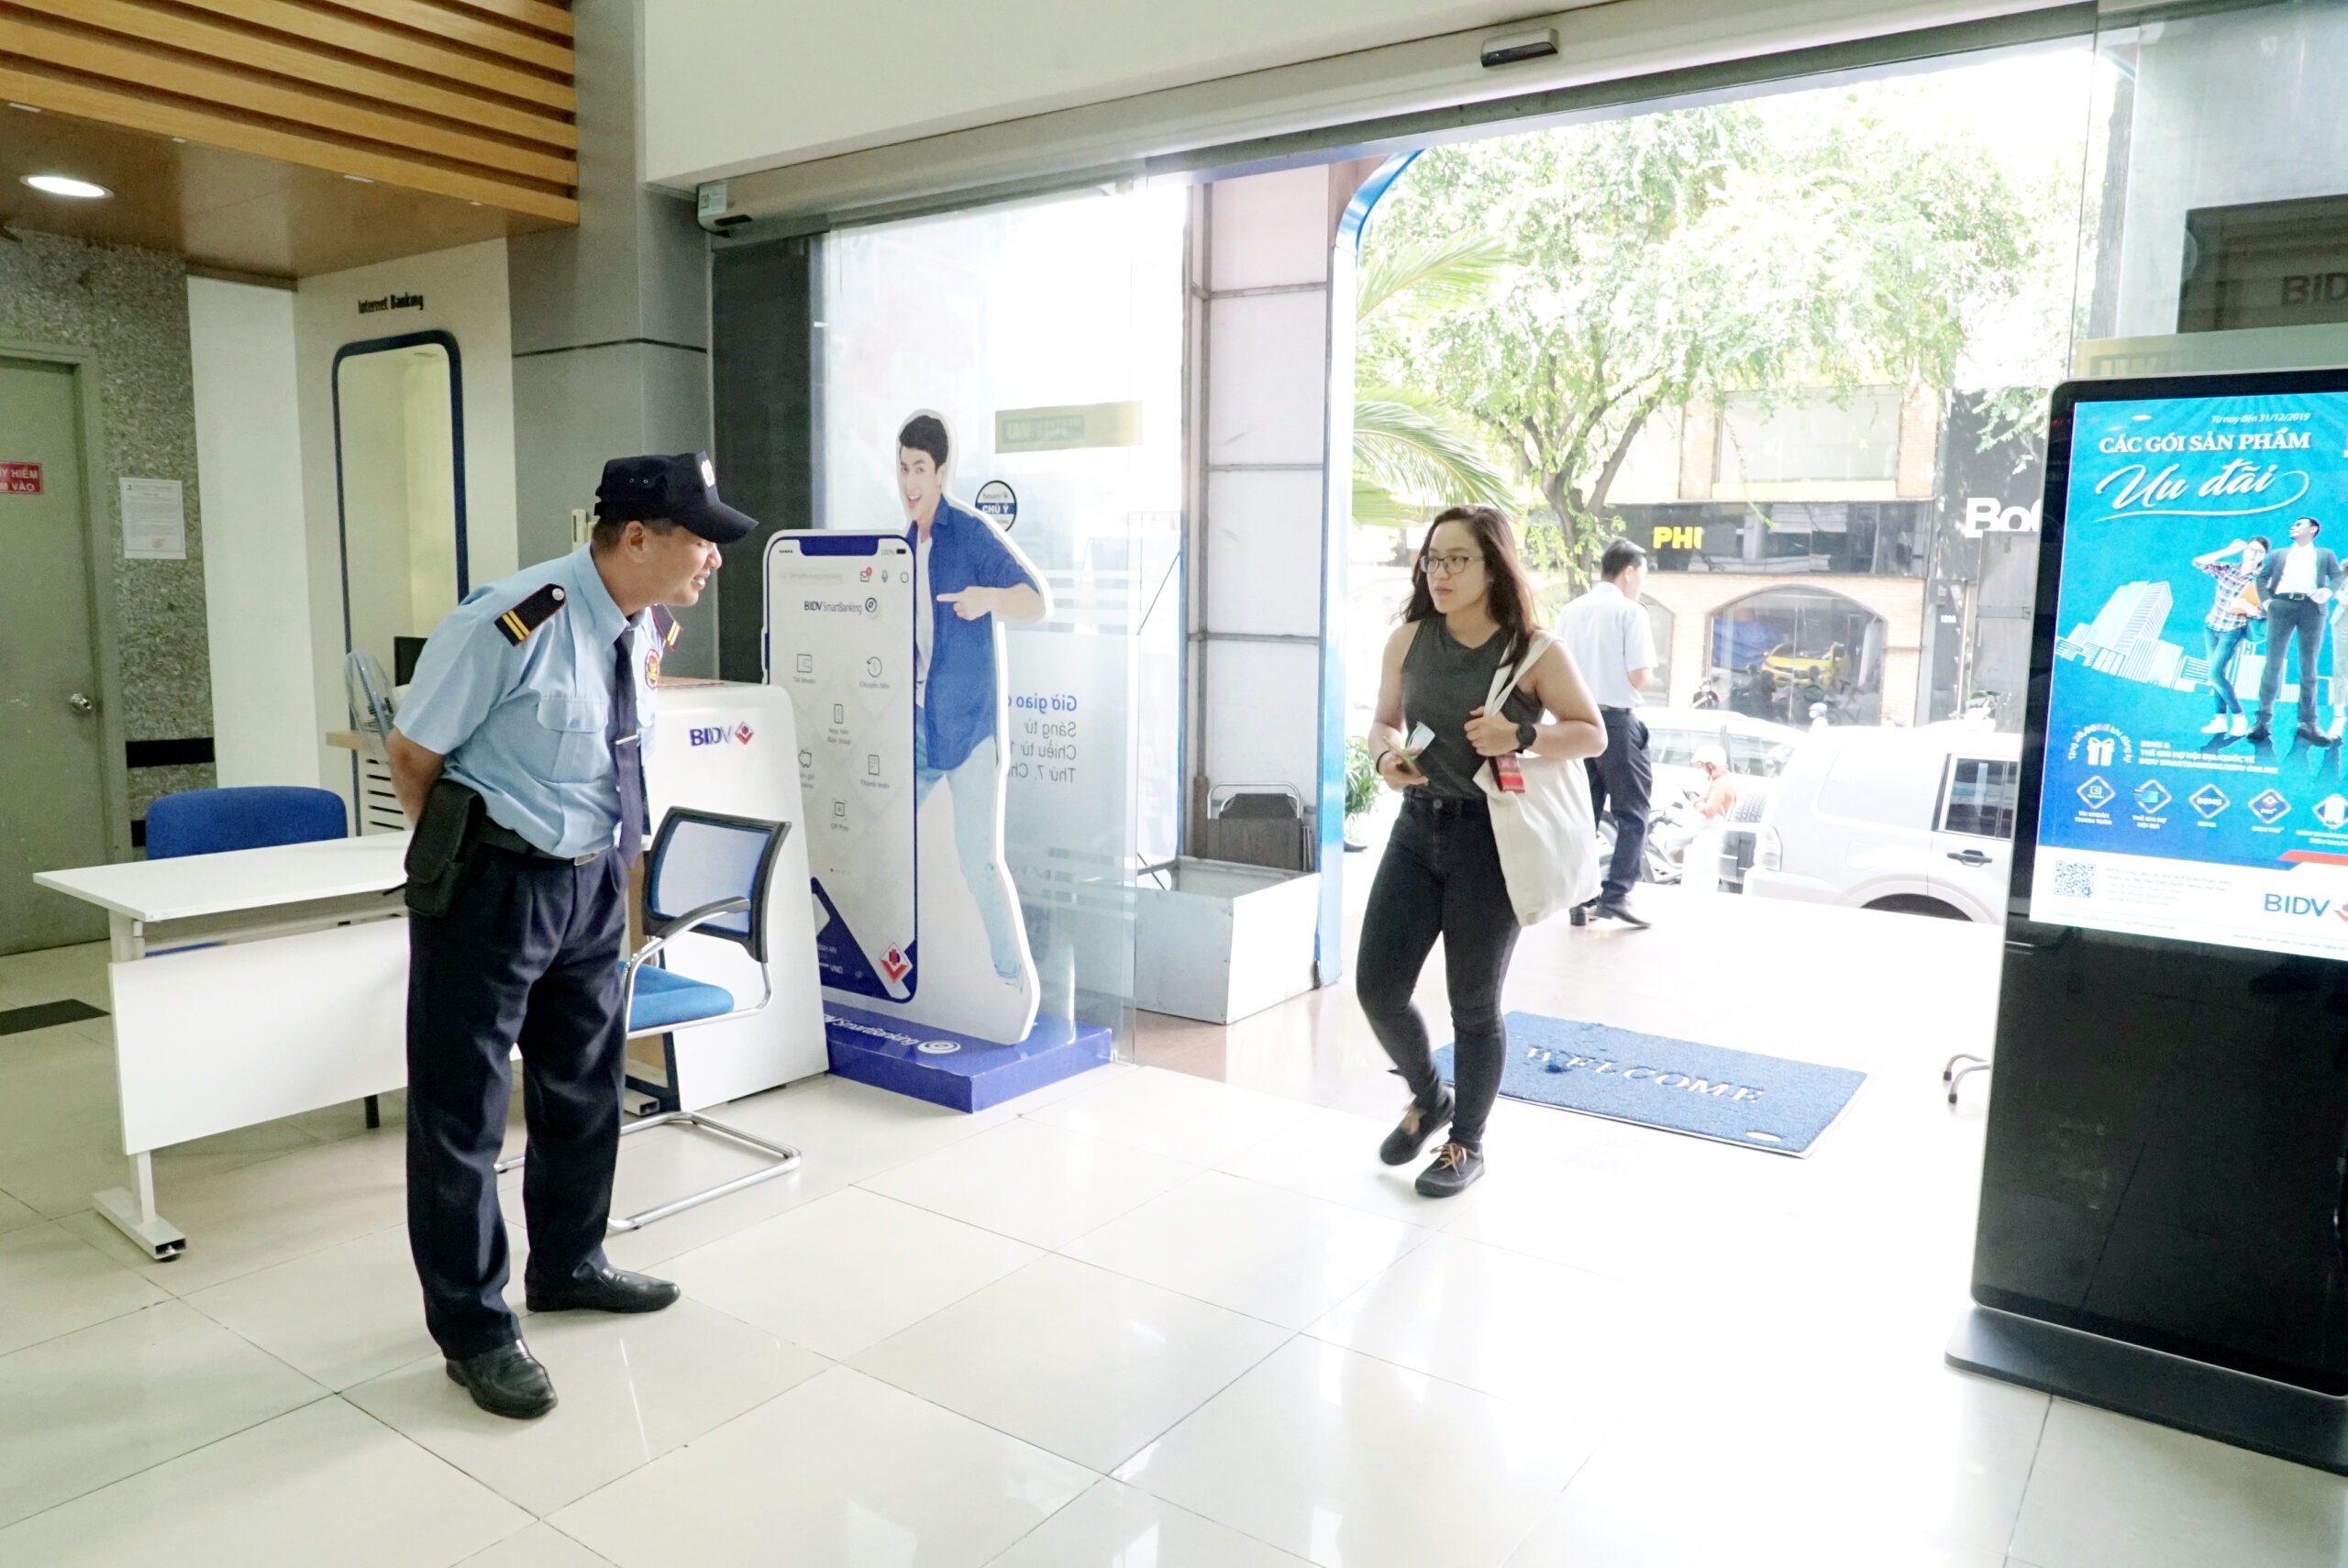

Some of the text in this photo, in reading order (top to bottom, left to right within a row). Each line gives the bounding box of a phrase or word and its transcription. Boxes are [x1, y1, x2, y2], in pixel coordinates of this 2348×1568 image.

[359, 292, 424, 315] Internet Banking
[2258, 413, 2311, 423] 31/12/2019
[2099, 433, 2143, 454] CÁC
[2145, 431, 2186, 453] GÓI
[2189, 430, 2233, 452] SẢN
[2198, 458, 2278, 498] đãi
[803, 601, 862, 615] BIDV SmartBanking
[690, 726, 732, 746] BIDV
[2264, 893, 2331, 917] BIDV
[1525, 1045, 1764, 1102] WELCOME
